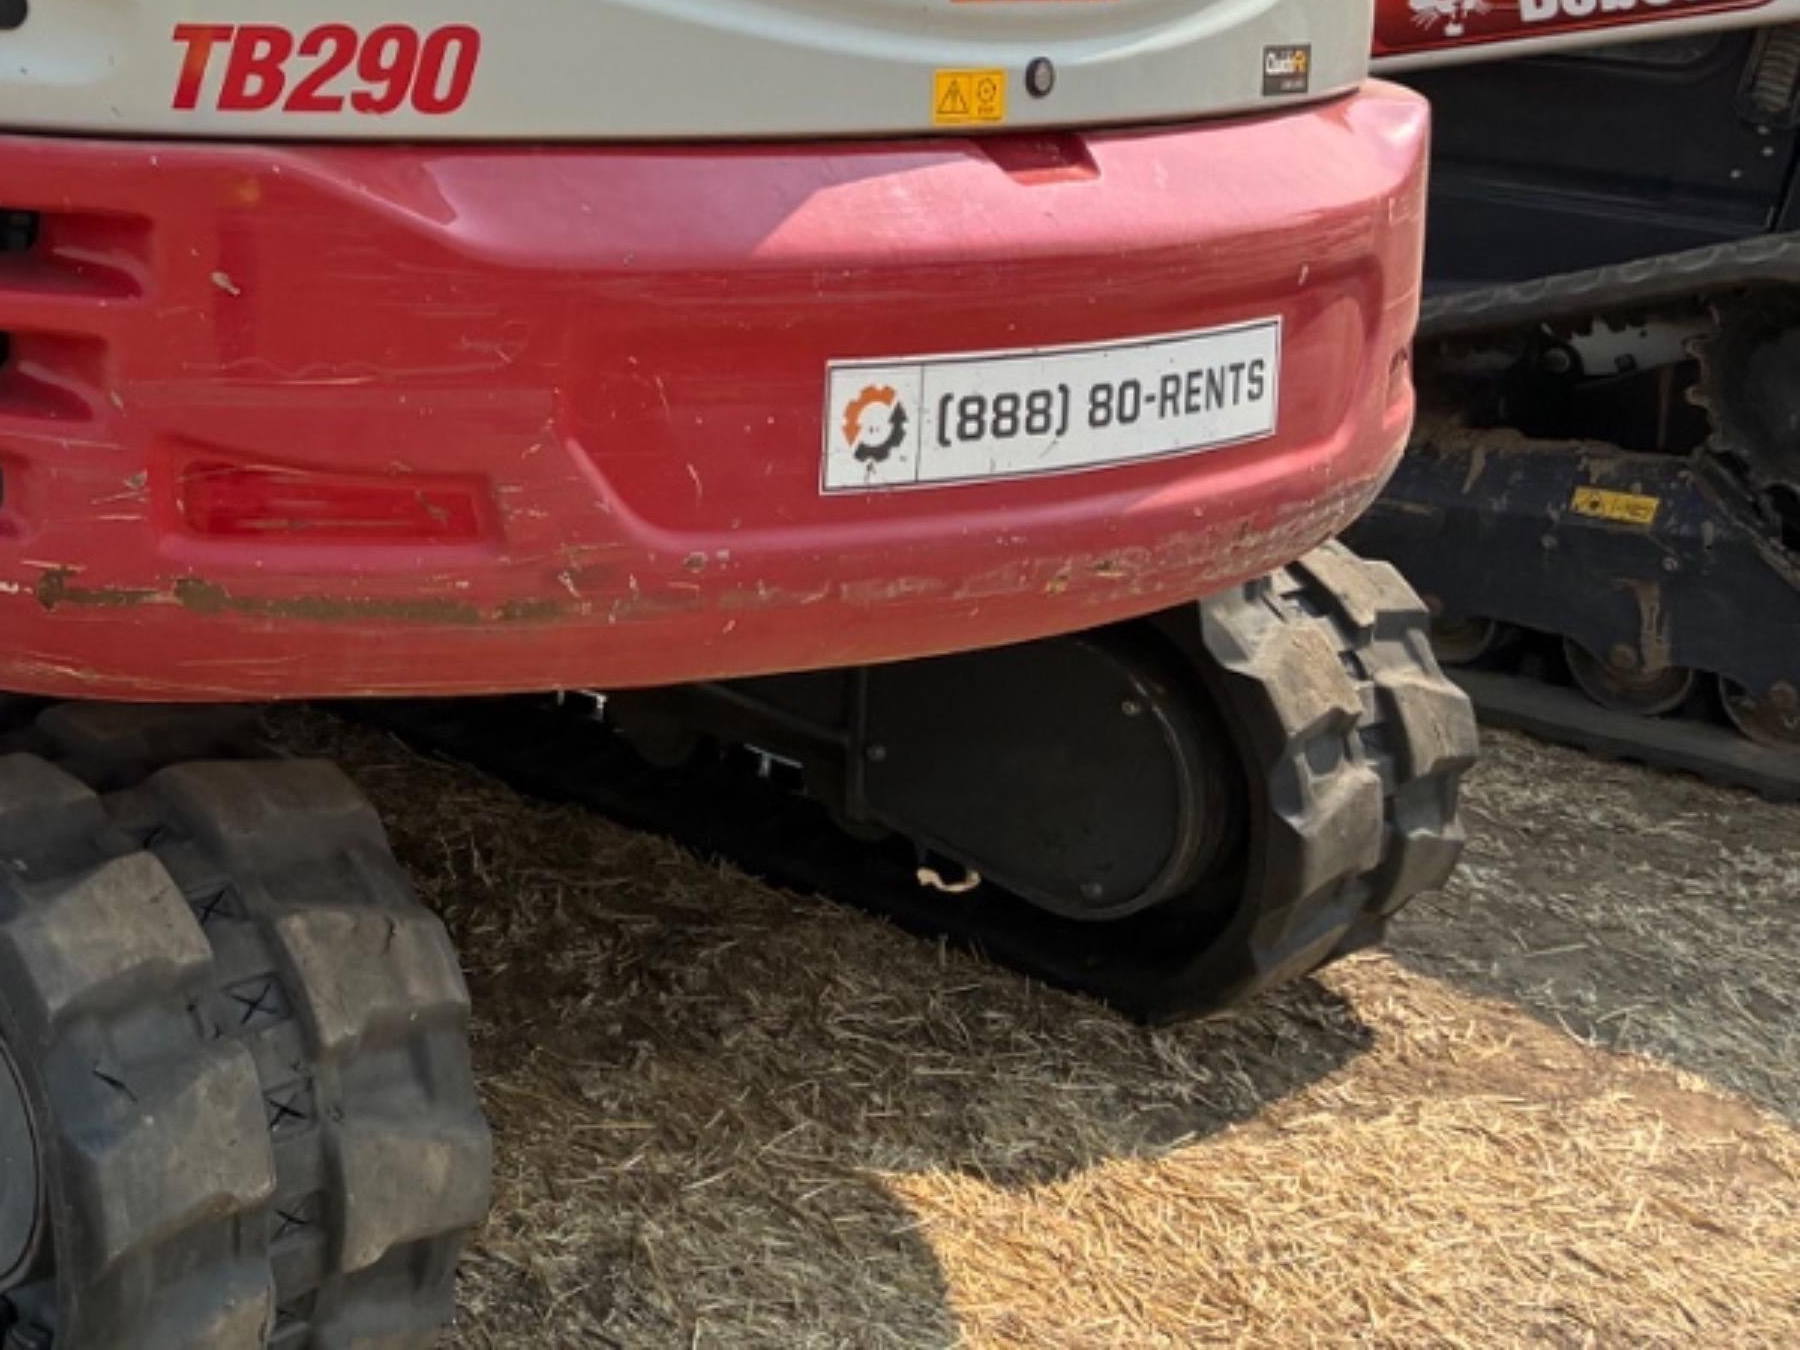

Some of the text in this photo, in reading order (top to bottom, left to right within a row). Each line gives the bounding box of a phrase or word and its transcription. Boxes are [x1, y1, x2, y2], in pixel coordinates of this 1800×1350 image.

[171, 23, 482, 115] TB290
[937, 359, 1265, 448] (888) 80-RENTS
